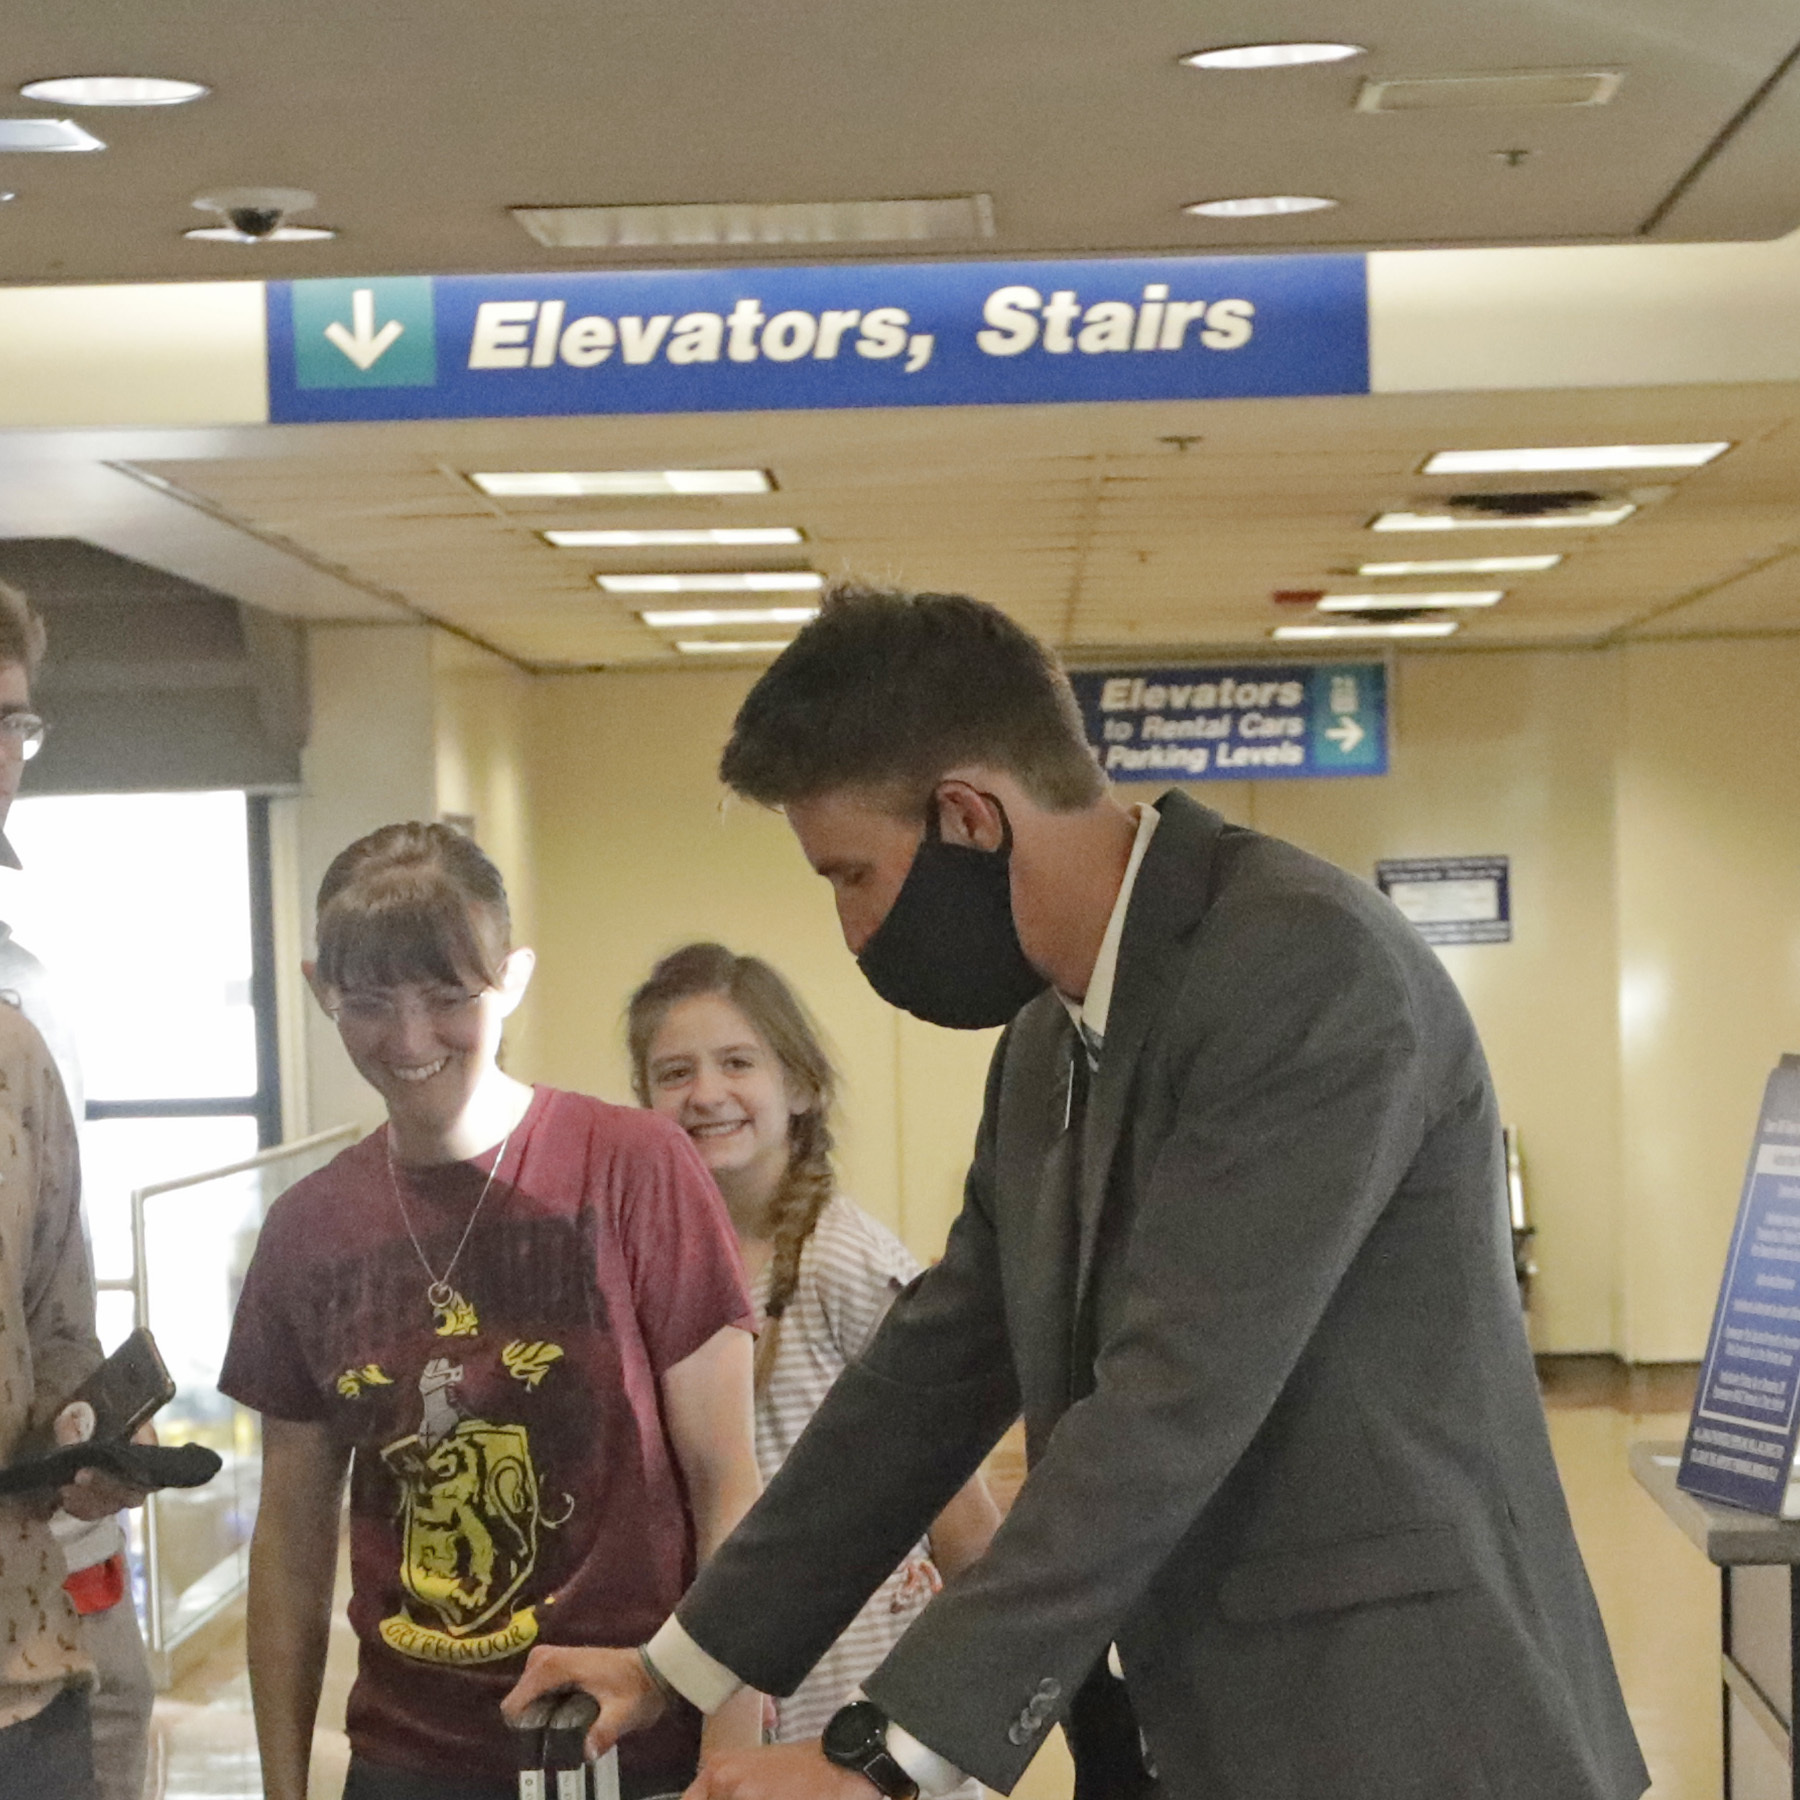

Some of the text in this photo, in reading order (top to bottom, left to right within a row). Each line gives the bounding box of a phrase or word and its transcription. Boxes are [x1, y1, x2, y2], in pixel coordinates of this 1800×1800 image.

[467, 283, 1255, 373] Elevators, Stairs
[1100, 677, 1305, 712] Elevators
[1103, 712, 1305, 742] to Rental Cars
[1105, 740, 1305, 774] Parking Levels
[386, 1622, 529, 1660] GRYFFINDOR
